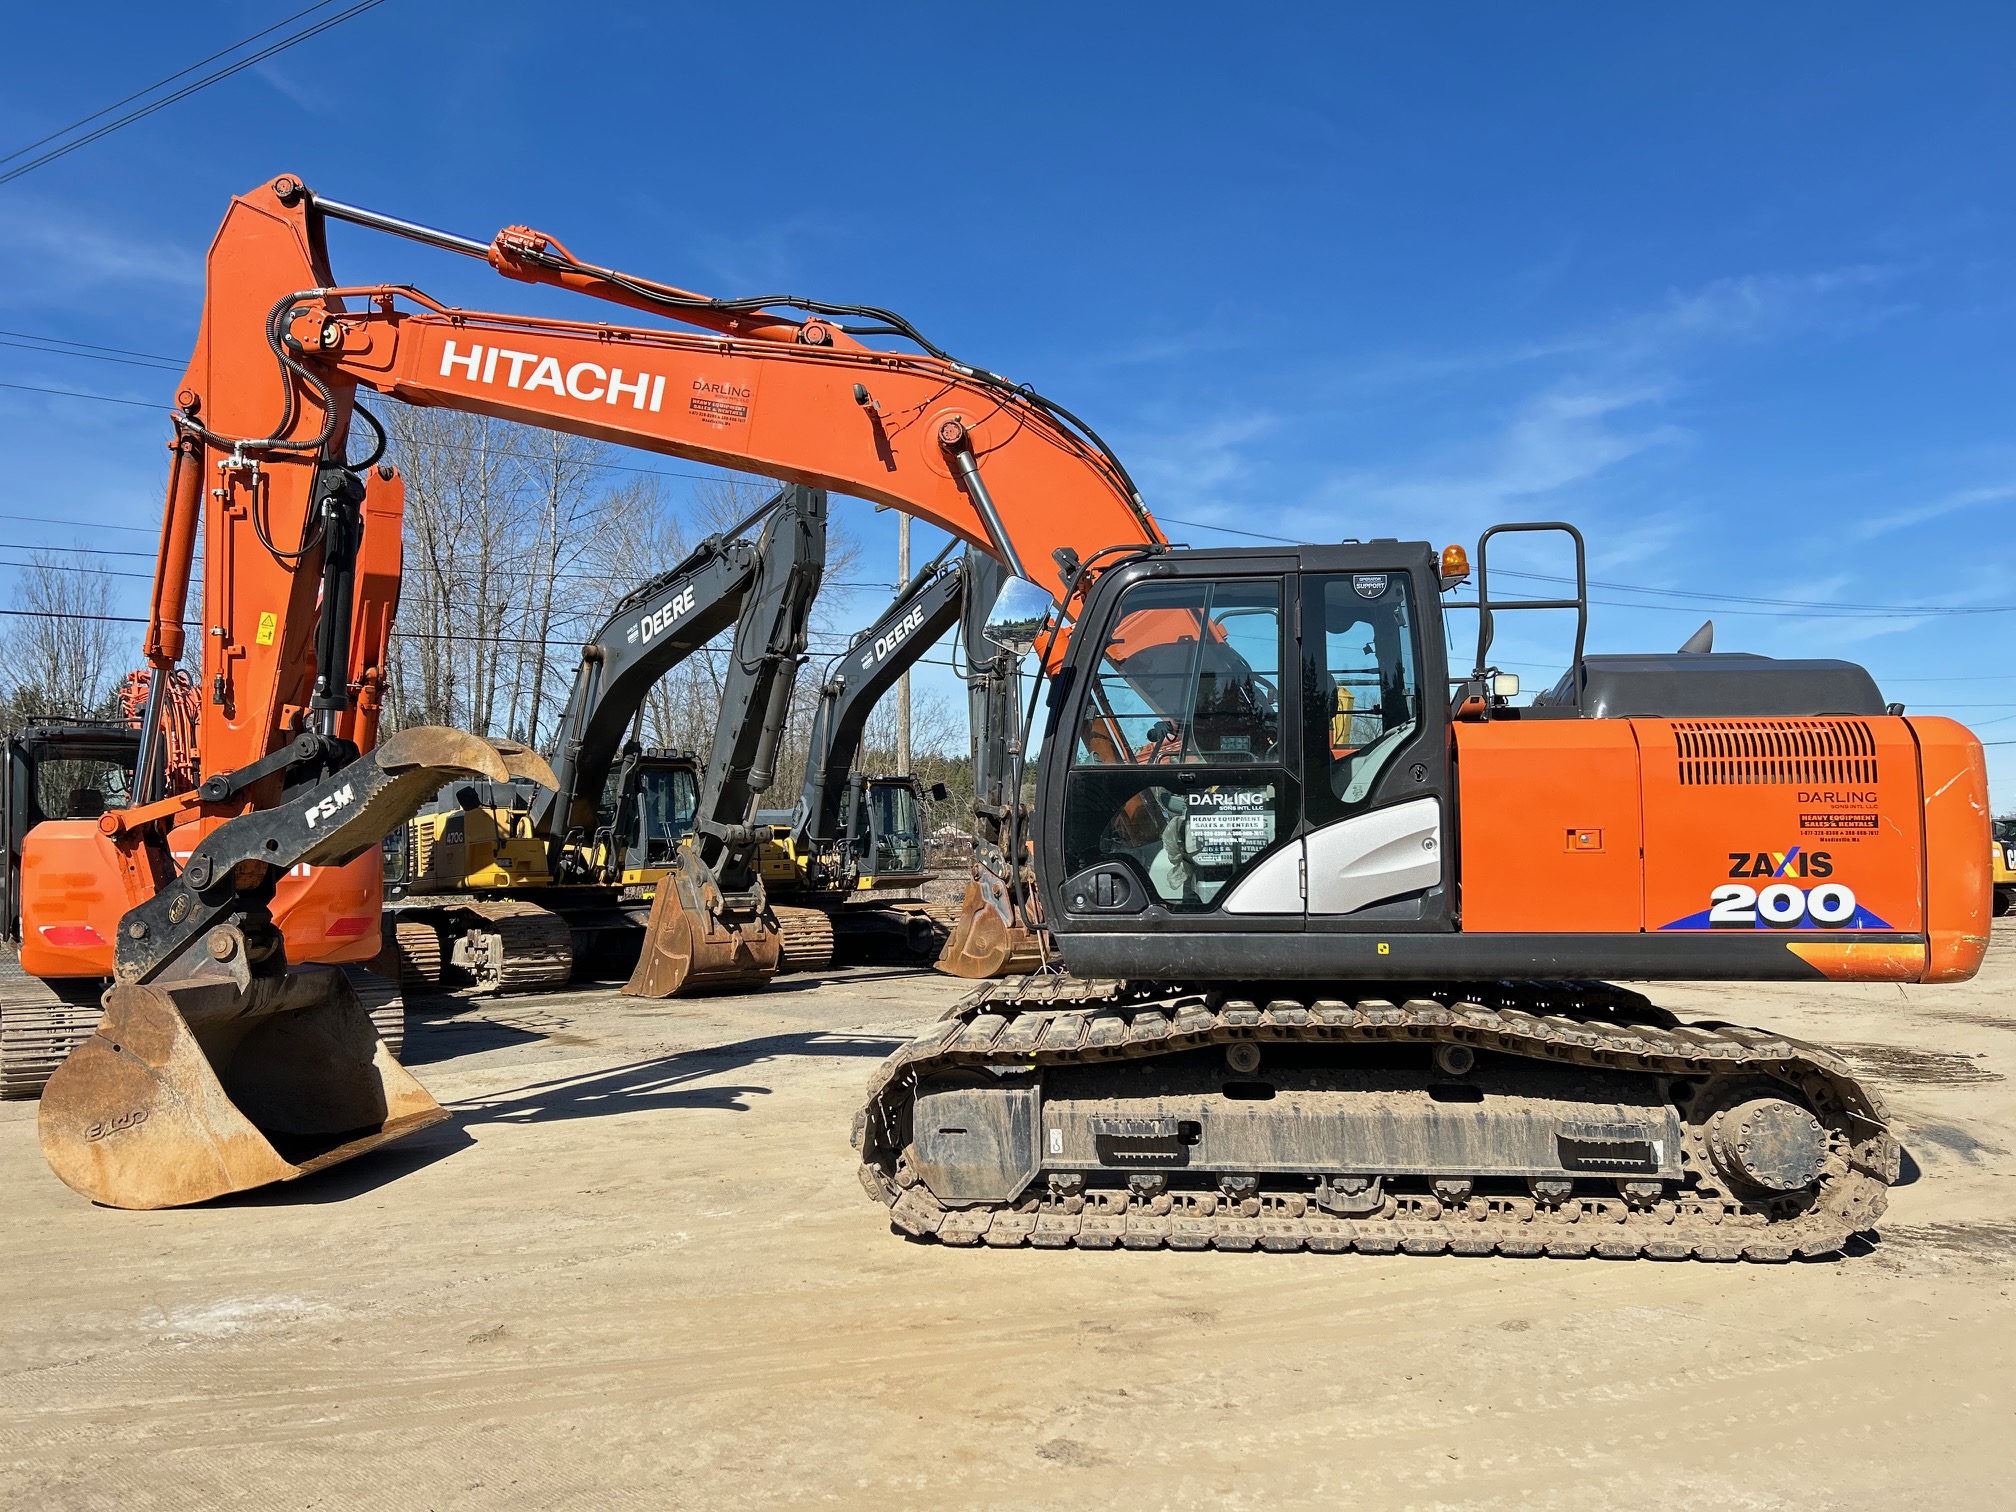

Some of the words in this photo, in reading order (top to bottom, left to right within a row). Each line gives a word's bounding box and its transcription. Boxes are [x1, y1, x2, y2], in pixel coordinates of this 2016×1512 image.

[440, 340, 666, 413] HITACHI
[692, 380, 751, 398] DARLING
[712, 402, 747, 412] EQUIPMENT
[718, 408, 744, 417] RENTALS
[641, 584, 695, 645] DEERE
[874, 604, 924, 662] DEERE
[1188, 793, 1263, 806] DARLING
[1798, 791, 1878, 803] DARLING
[446, 831, 464, 844] 470G
[1728, 846, 1833, 878] ZAXIS
[1709, 883, 1857, 929] 200
